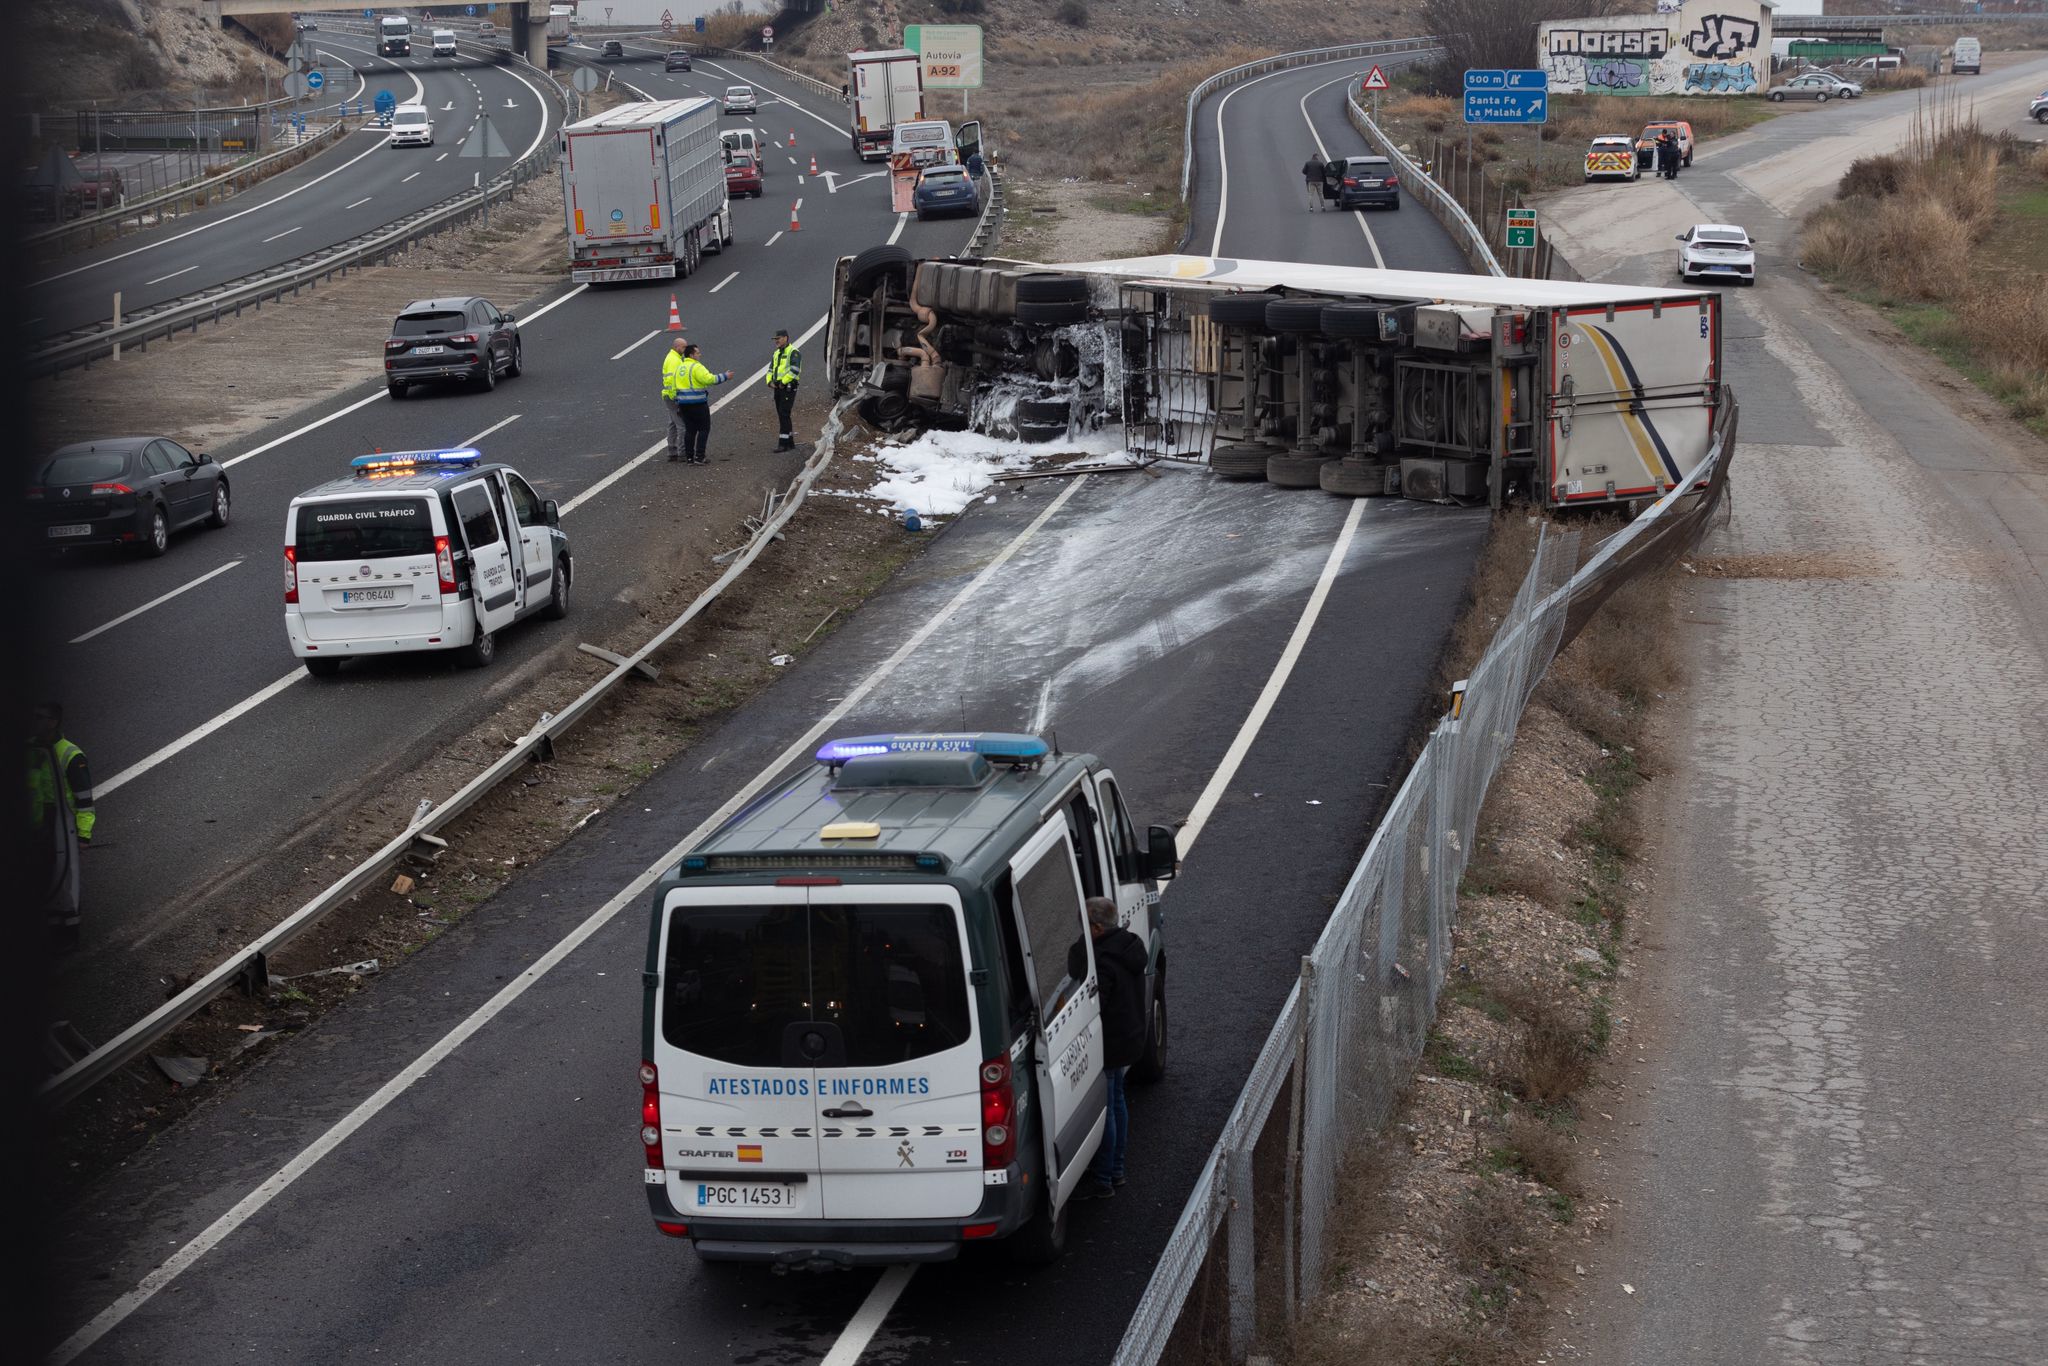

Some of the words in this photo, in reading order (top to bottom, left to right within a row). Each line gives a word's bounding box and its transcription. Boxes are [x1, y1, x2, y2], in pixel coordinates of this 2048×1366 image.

[926, 51, 962, 60] Autovía
[930, 66, 956, 76] A-92
[1468, 75, 1490, 84] 500
[1492, 76, 1502, 84] m
[1469, 96, 1500, 105] Santa
[1504, 96, 1517, 105] Fe
[1468, 108, 1481, 117] La
[1484, 107, 1522, 117] Malahá
[1517, 236, 1525, 245] 0
[317, 513, 354, 522] GUARDIA
[378, 508, 415, 518] TRÁFICO
[347, 591, 367, 602] PGC
[890, 741, 938, 750] GUARDIA
[942, 740, 971, 748] CIVIL
[708, 1078, 809, 1096] ATESTADOS
[818, 1079, 828, 1095] E
[832, 1077, 929, 1095] INFORMES
[678, 1149, 734, 1158] CRAFTER
[945, 1149, 968, 1158] TDI
[706, 1186, 738, 1204] PGC
